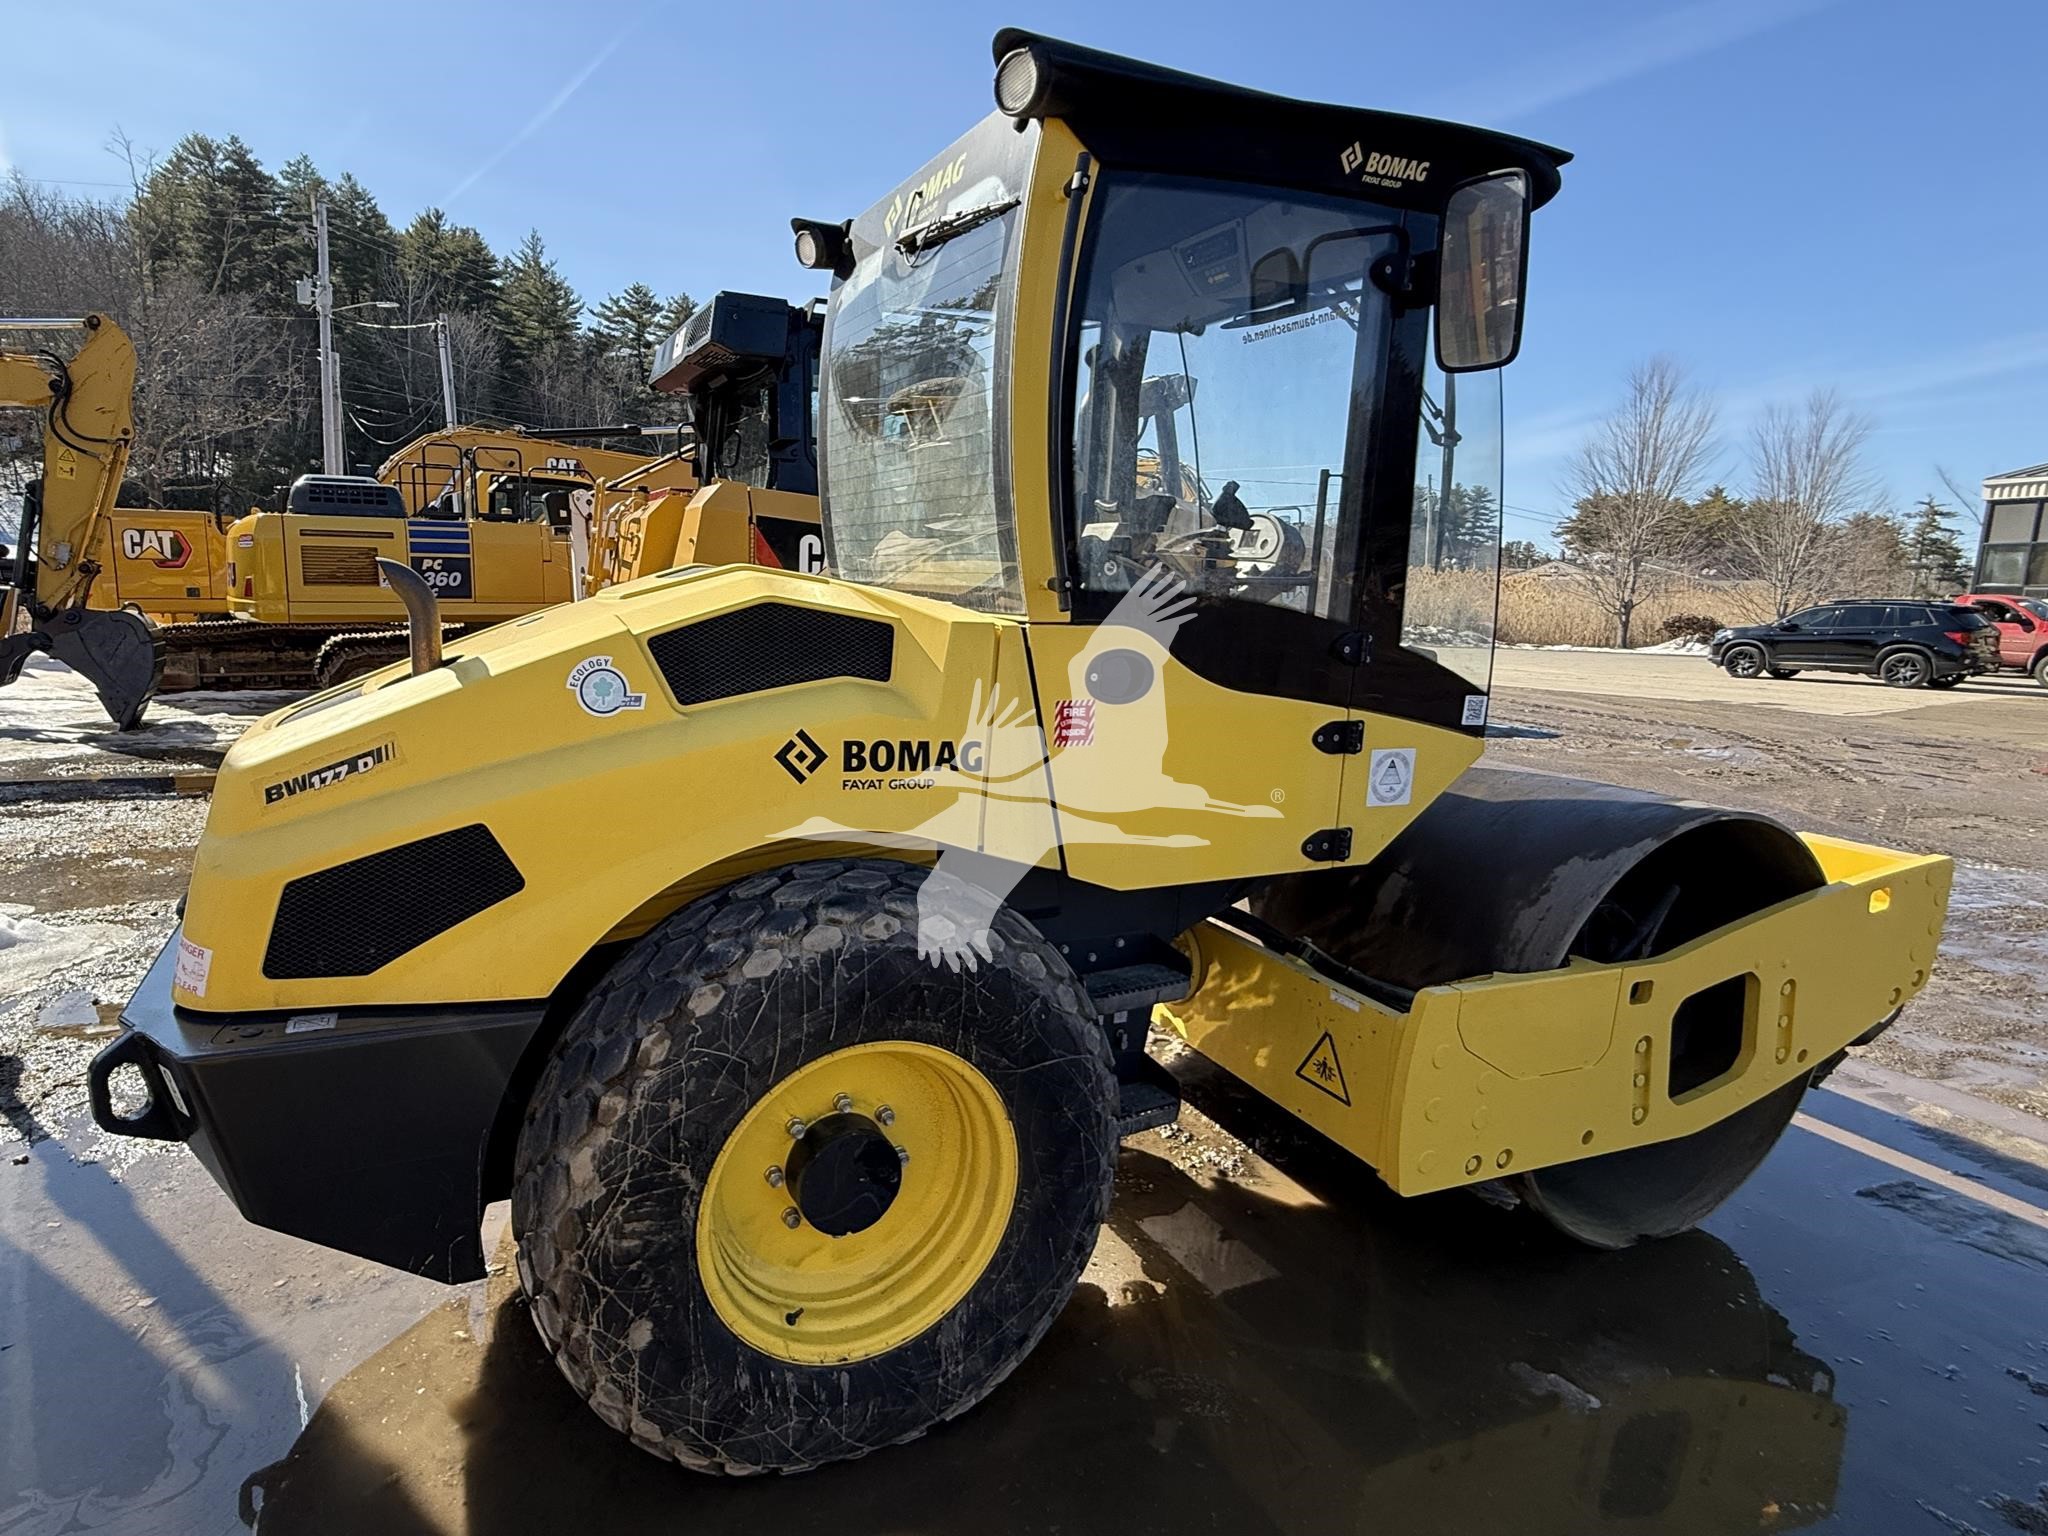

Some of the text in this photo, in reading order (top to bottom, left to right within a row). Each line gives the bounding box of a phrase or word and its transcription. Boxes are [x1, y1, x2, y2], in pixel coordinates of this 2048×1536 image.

[1365, 151, 1430, 182] BOMAG
[546, 457, 577, 477] CAT
[123, 529, 174, 560] CAT
[421, 559, 443, 570] PC
[423, 571, 462, 587] 360
[569, 658, 610, 688] ECOLOGY
[1063, 707, 1086, 717] FIRE
[843, 740, 983, 773] BOMAG
[842, 778, 935, 790] FAYAT GROUP
